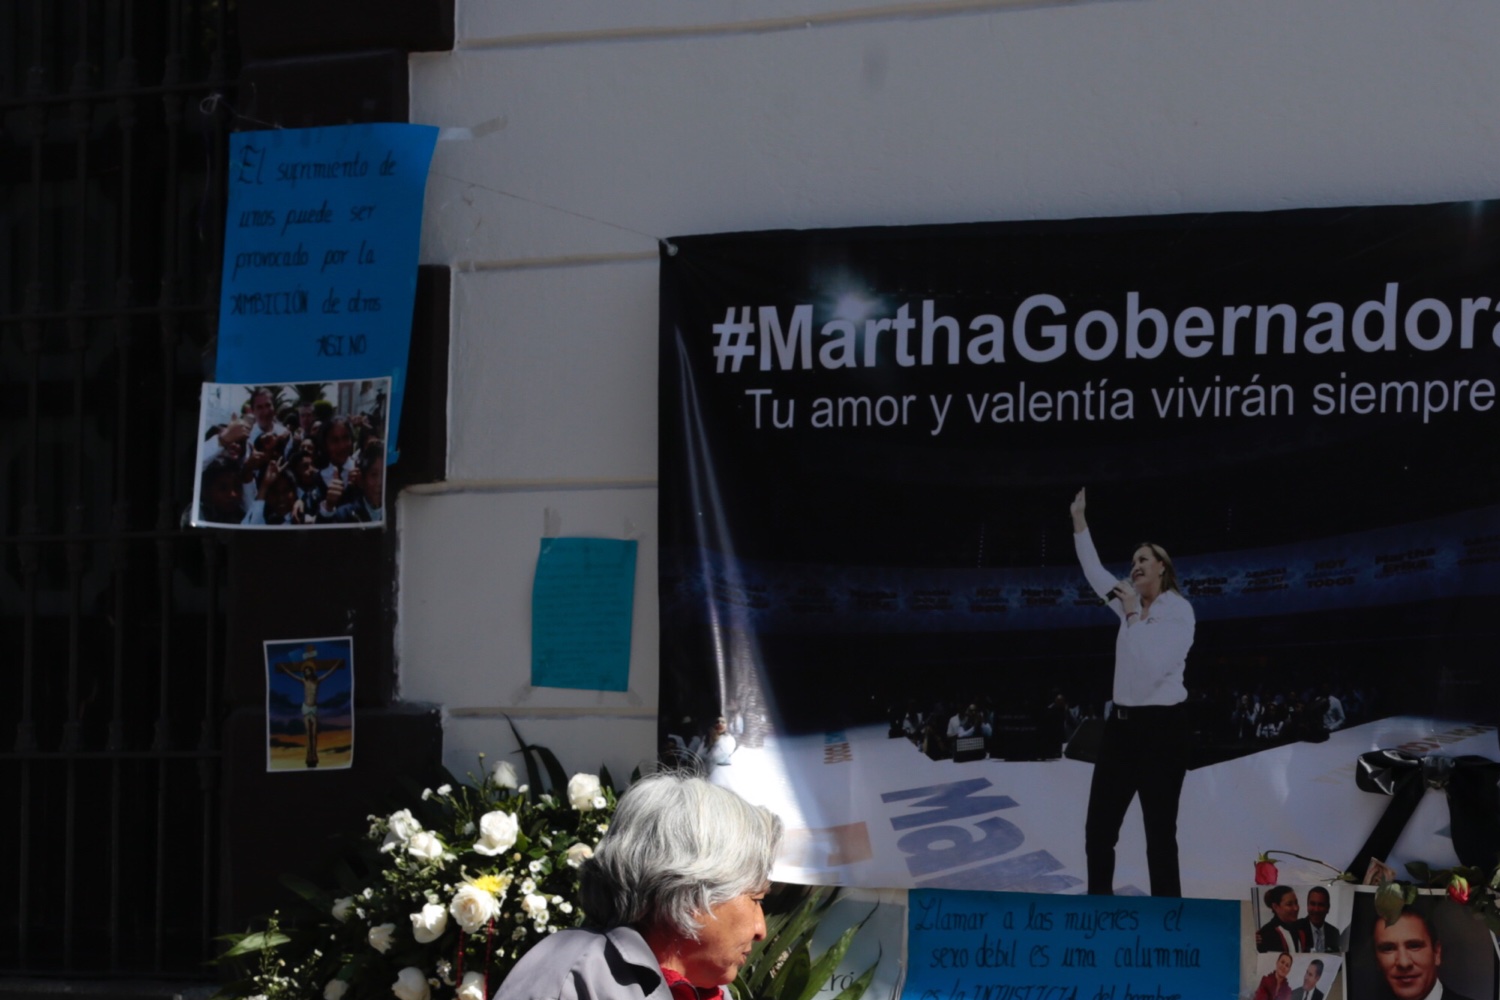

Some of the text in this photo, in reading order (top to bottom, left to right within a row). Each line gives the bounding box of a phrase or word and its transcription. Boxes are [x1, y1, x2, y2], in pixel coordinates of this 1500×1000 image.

[236, 145, 266, 184] El
[379, 150, 398, 176] de
[239, 199, 376, 237] unos puede ser
[232, 240, 375, 282] provocado por la
[322, 287, 340, 314] de
[347, 289, 382, 312] otros
[746, 370, 1497, 435] Tu amor y valentía vivirán siempre
[914, 898, 1184, 939] Llamar a las mujeres el
[929, 943, 969, 968] sexo
[1028, 943, 1050, 968] es
[1061, 945, 1098, 968] una
[1114, 936, 1202, 969] calumnia
